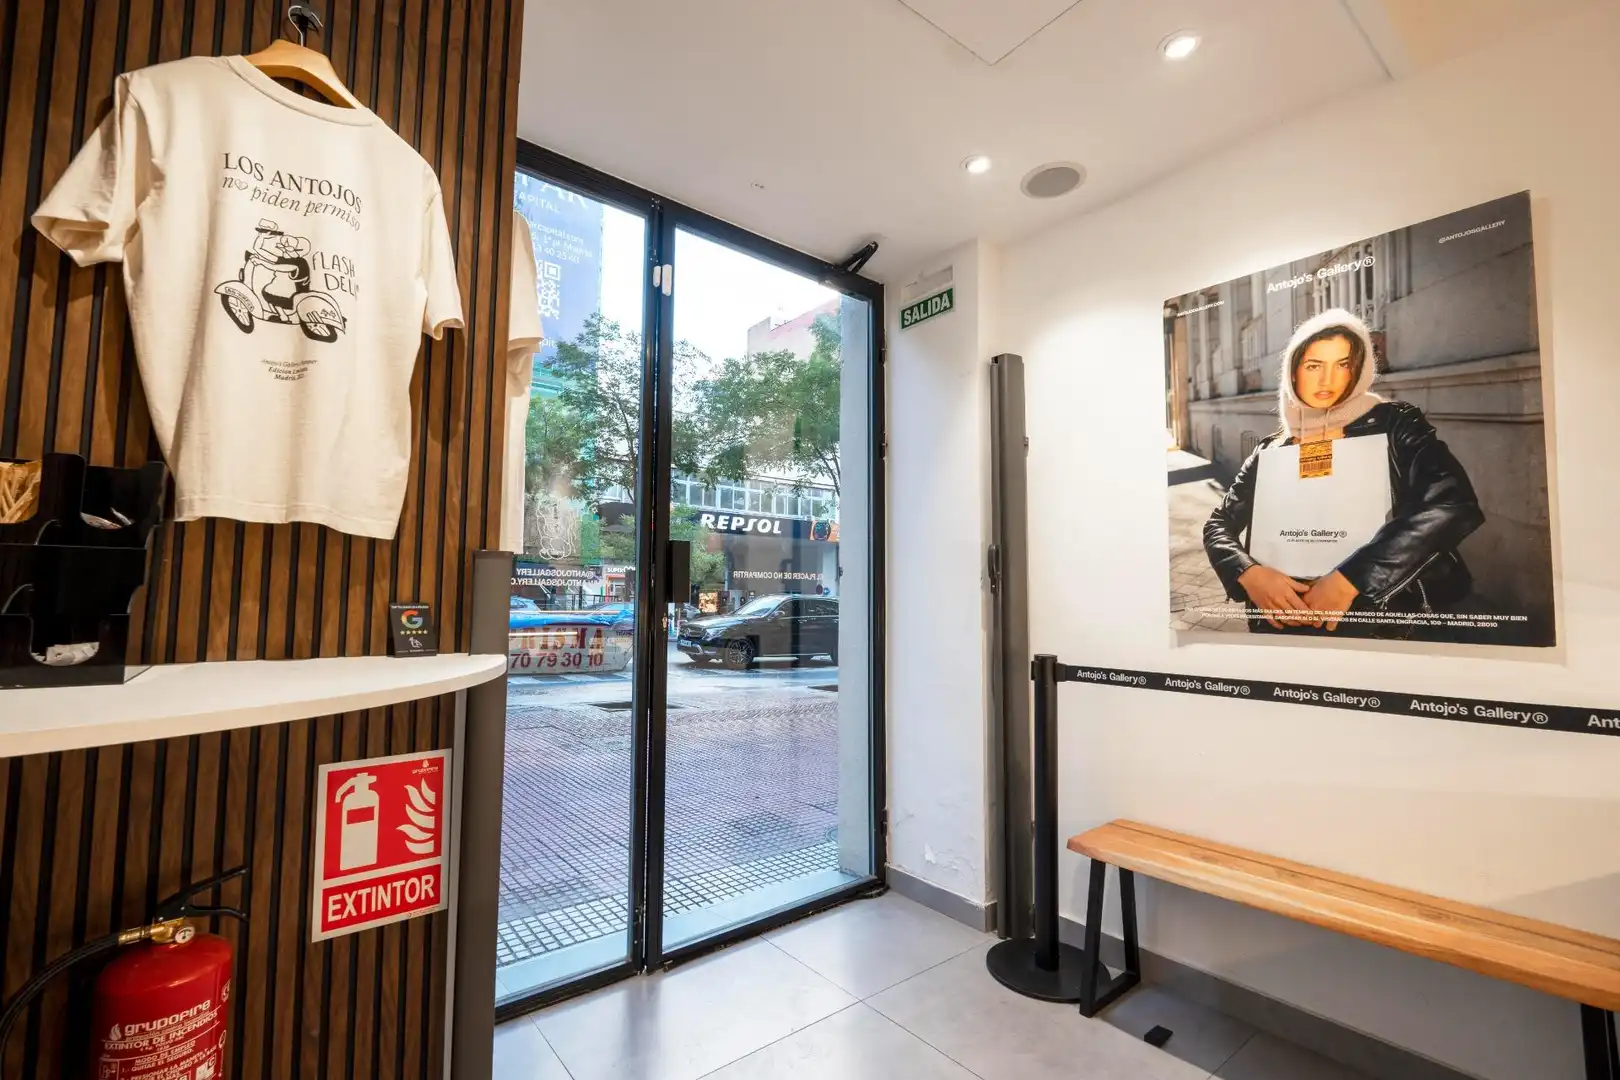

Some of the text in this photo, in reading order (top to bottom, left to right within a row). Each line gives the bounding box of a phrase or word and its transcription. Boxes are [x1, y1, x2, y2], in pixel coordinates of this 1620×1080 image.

[223, 153, 362, 214] LOS ANTOJOS
[250, 185, 300, 211] piden
[303, 200, 361, 231] permiso
[312, 250, 356, 278] FLASH
[1266, 273, 1313, 294] Antojo's
[904, 292, 951, 326] SALIDA
[701, 513, 782, 534] REPSOL
[1280, 529, 1308, 538] Antojo's
[1077, 669, 1107, 681] Antojo's
[1165, 677, 1201, 690] Antojo's
[1273, 686, 1319, 701] Antojo's
[1410, 699, 1469, 716] Antojo's
[327, 874, 435, 923] EXTINTOR
[104, 1039, 150, 1052] EXTINTOR
[153, 1035, 166, 1046] DE
[169, 1010, 218, 1040] INCENDIOS
